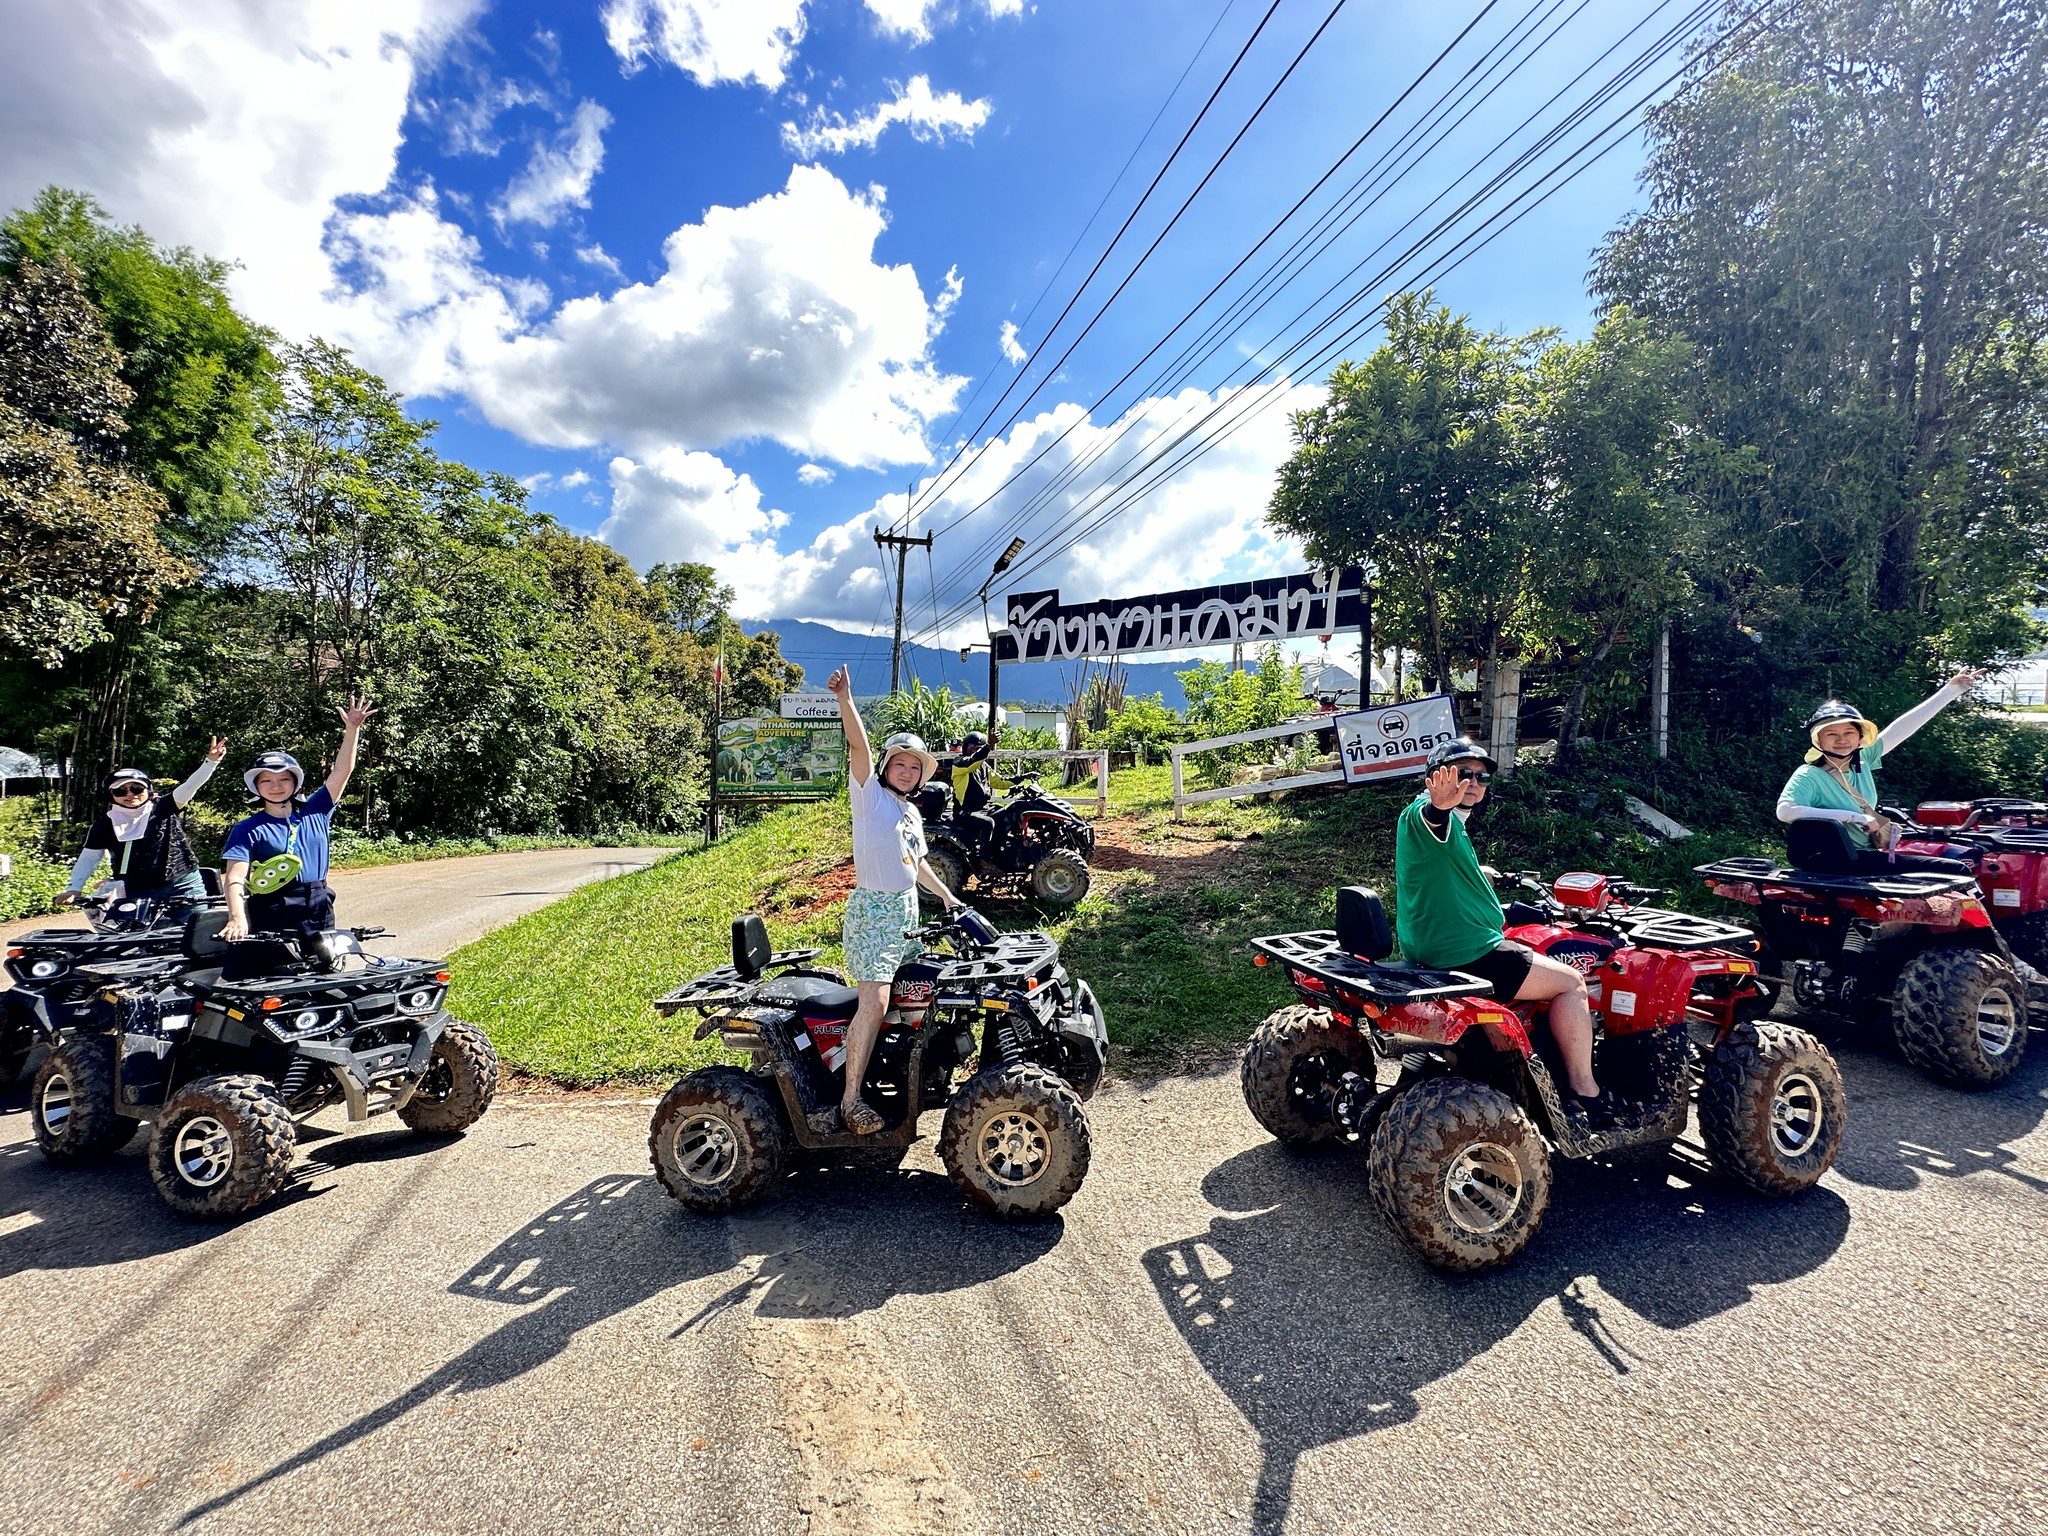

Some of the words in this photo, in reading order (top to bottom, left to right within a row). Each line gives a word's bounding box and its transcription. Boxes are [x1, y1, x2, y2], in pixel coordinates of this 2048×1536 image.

[795, 707, 828, 716] Coffee
[758, 721, 802, 729] INTHANON
[803, 721, 842, 729] PARADISE
[813, 1025, 849, 1035] HUSK
